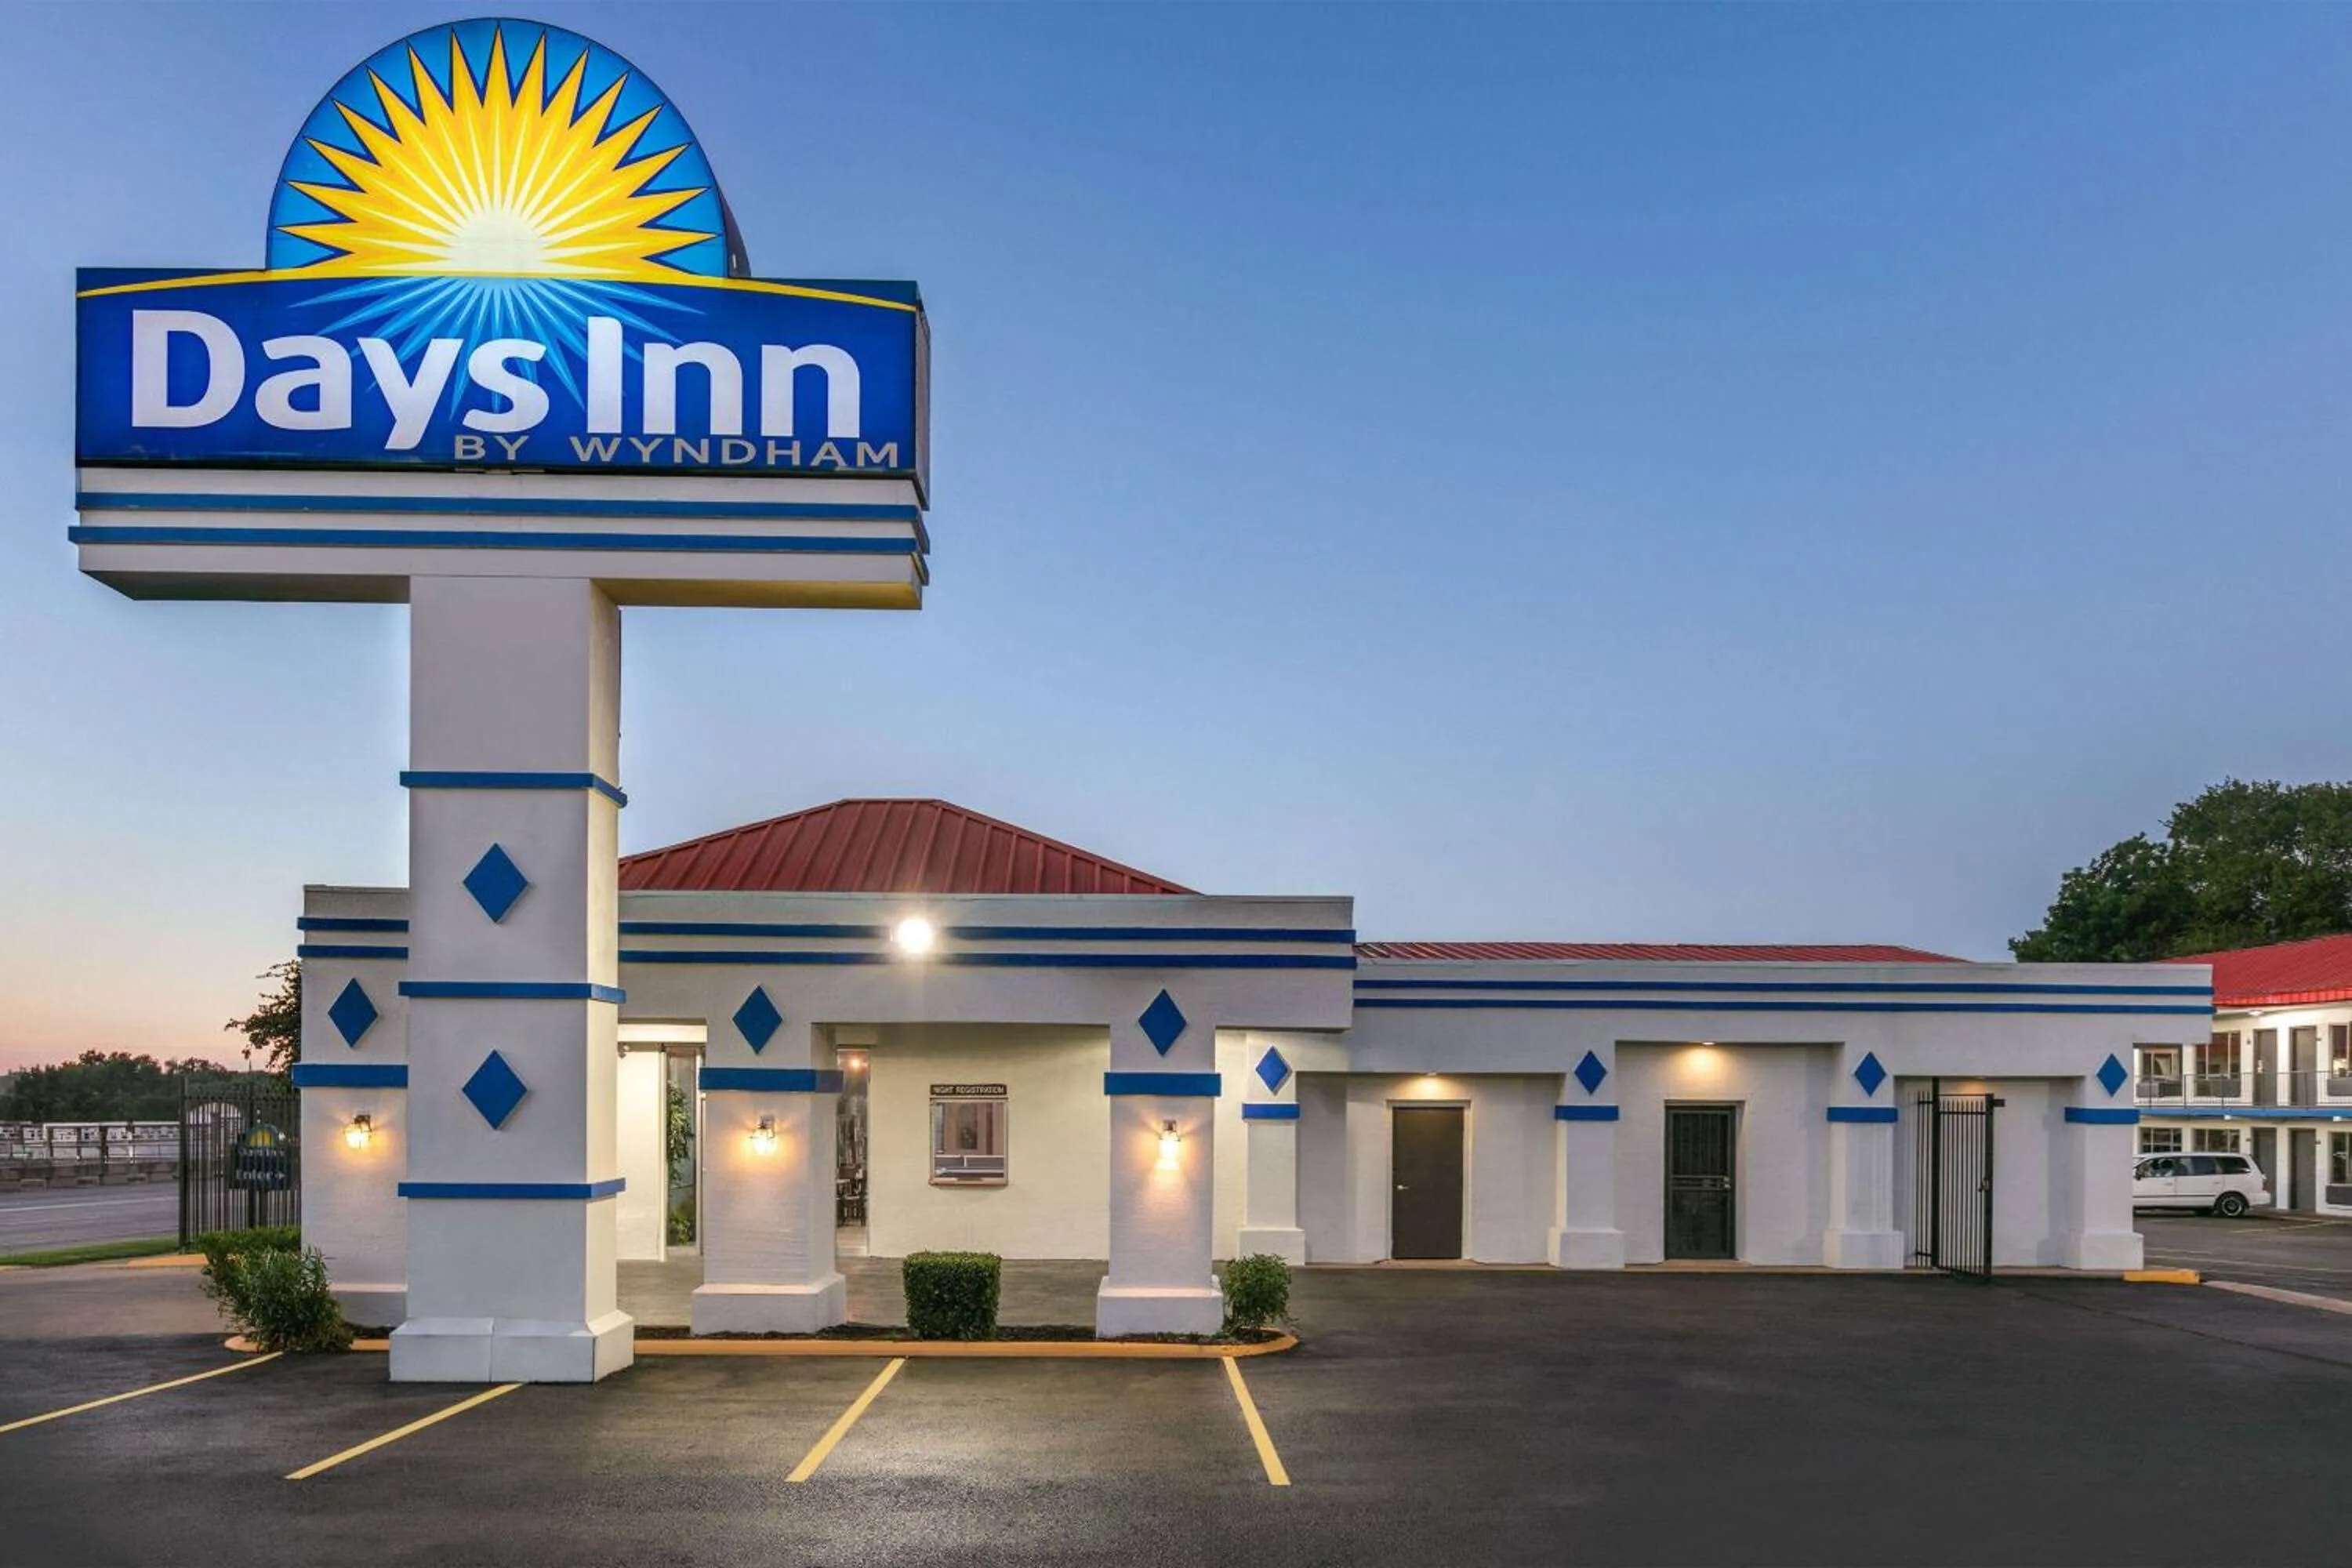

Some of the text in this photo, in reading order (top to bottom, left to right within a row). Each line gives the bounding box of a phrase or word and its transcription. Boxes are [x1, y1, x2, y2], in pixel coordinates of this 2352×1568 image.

[132, 310, 860, 449] Days Inn
[453, 435, 898, 468] BY WYNDHAM
